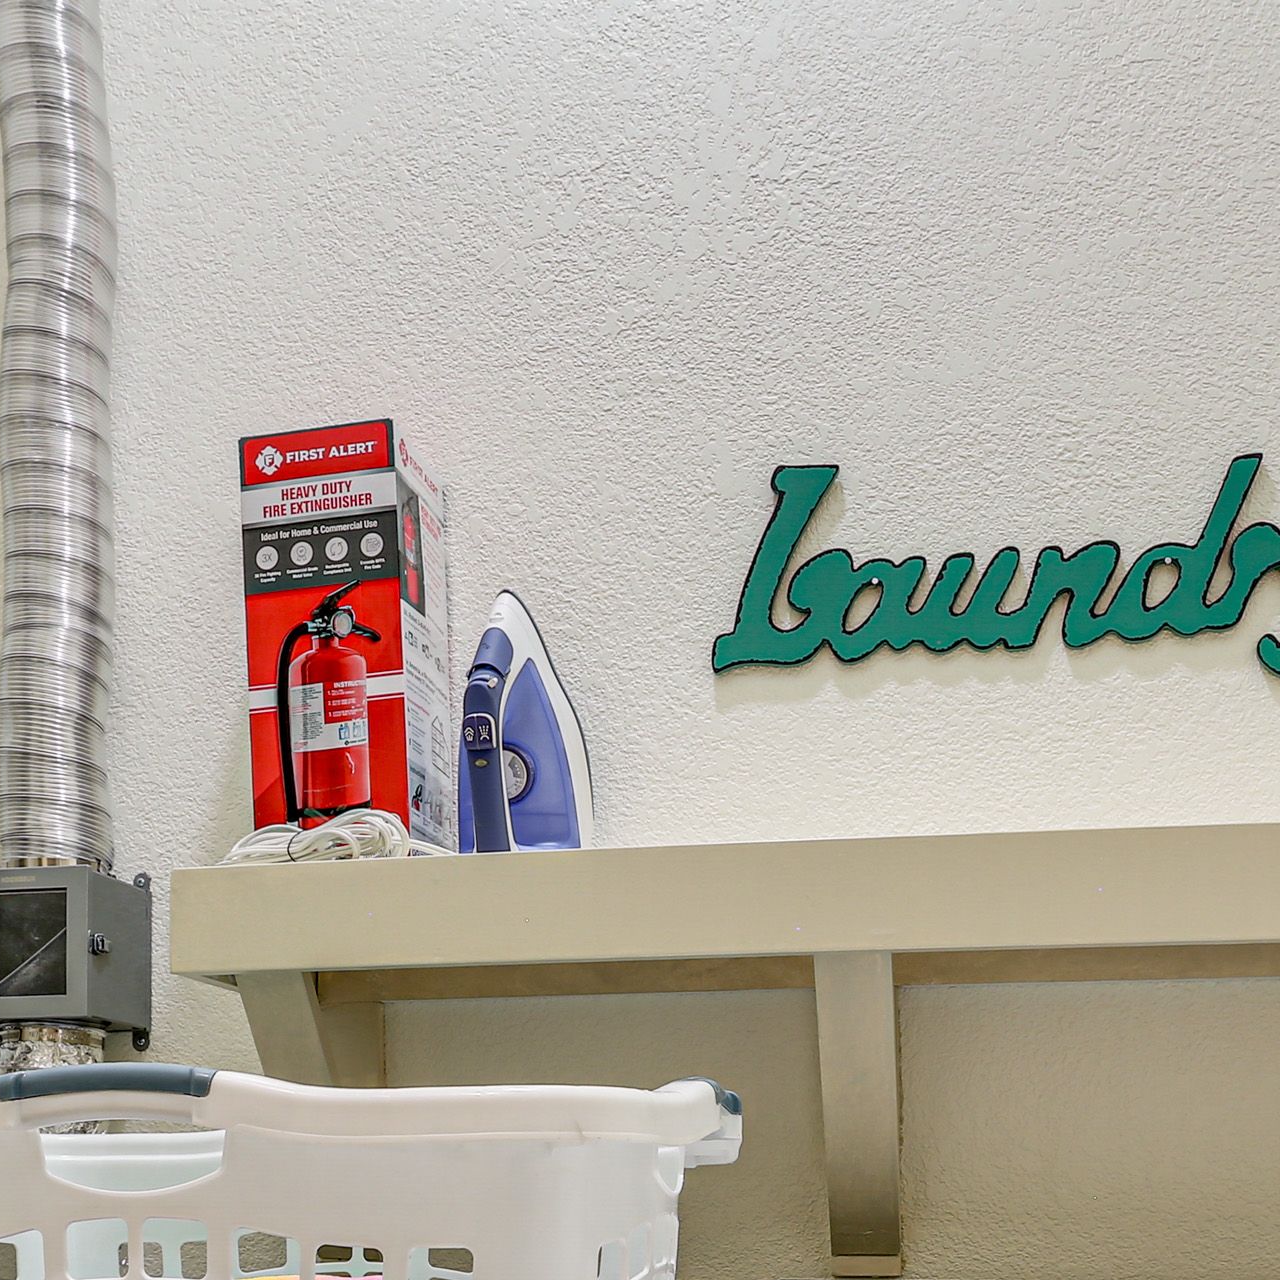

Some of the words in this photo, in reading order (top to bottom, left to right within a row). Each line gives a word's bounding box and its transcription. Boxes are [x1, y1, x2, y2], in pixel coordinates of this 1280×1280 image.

[285, 447, 326, 463] FIRST
[329, 441, 376, 457] ALERT
[281, 485, 318, 501] HEAVY
[322, 480, 352, 495] DUTY
[263, 504, 287, 518] FIRE
[290, 492, 372, 515] EXTINGUISHER
[261, 532, 278, 541] Ideal
[280, 531, 290, 539] for
[291, 528, 312, 538] Home
[313, 526, 319, 535] &
[320, 521, 363, 534] Commercial
[364, 520, 378, 528] Use
